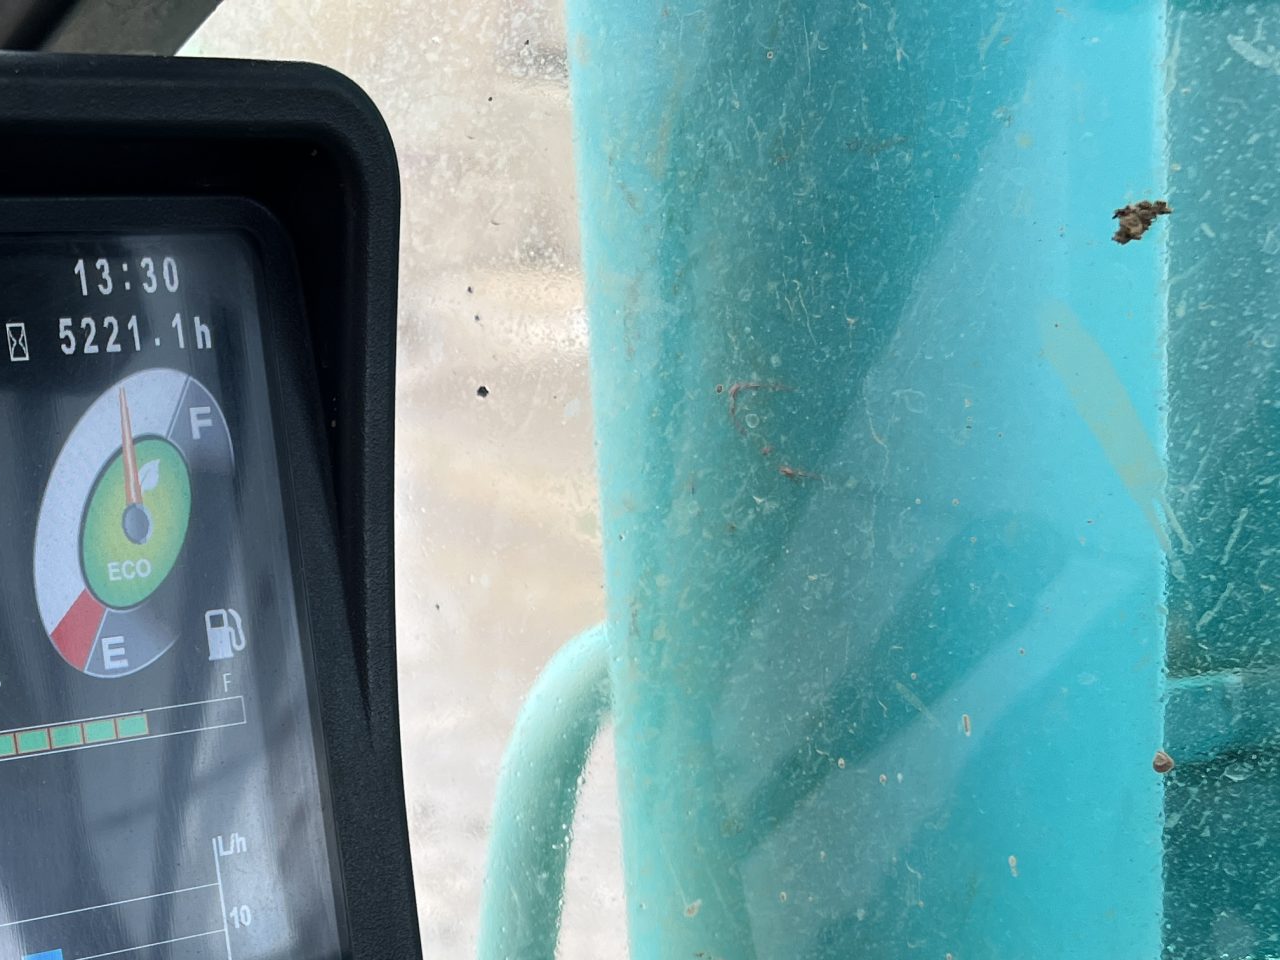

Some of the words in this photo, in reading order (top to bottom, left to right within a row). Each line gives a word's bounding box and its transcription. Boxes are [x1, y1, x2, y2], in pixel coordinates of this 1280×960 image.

[74, 257, 179, 296] 13:30
[188, 406, 214, 440] F
[107, 558, 152, 582] ECO
[101, 636, 129, 670] E
[222, 672, 232, 693] F
[229, 904, 252, 929] 10
